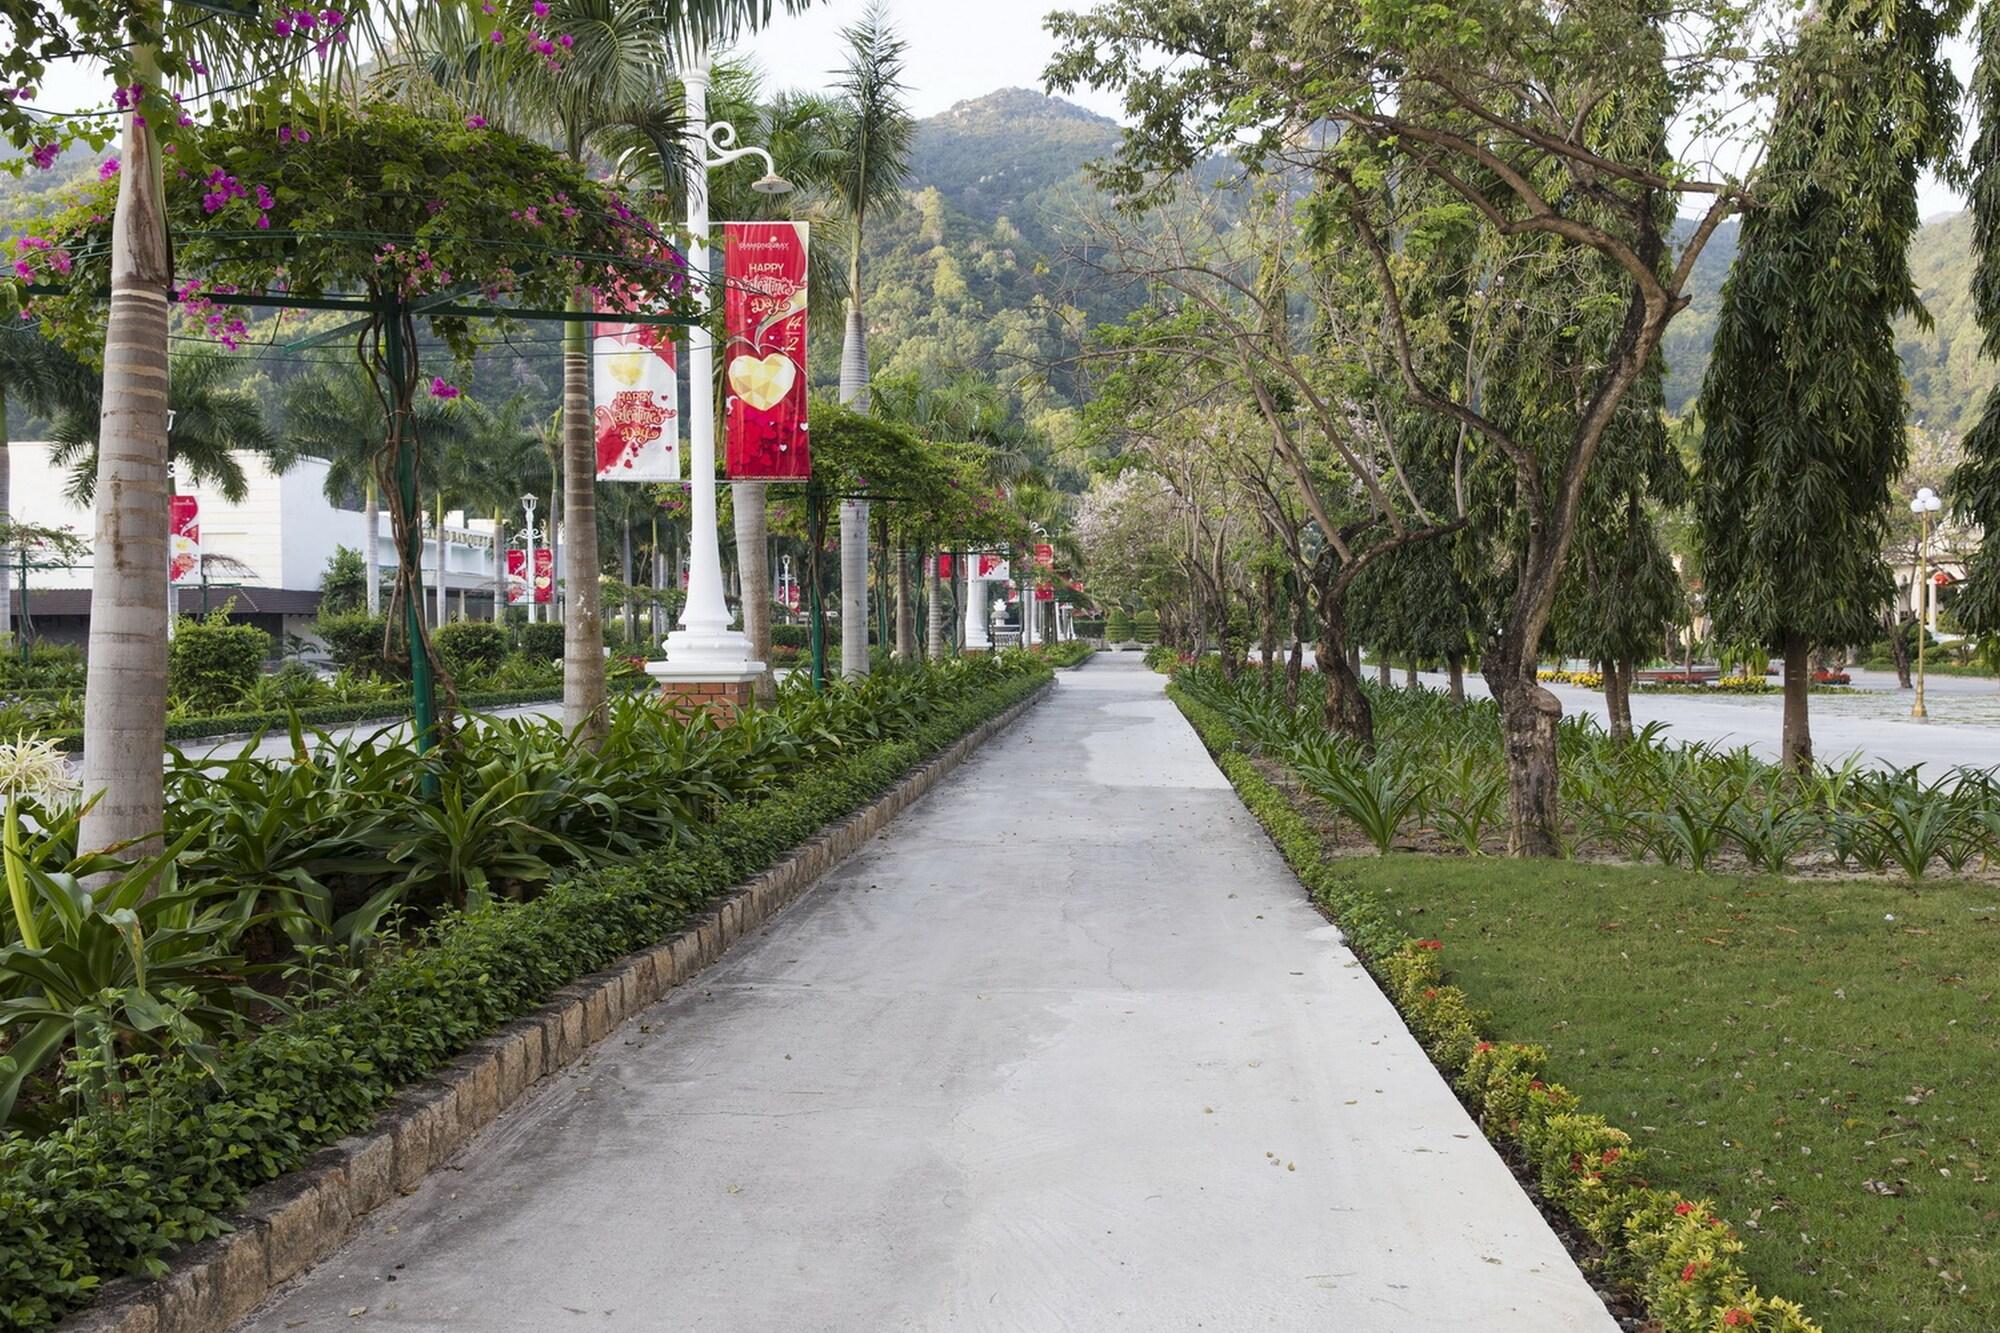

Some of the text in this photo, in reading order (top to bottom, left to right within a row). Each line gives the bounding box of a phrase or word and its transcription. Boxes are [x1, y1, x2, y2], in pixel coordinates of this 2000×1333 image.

[748, 263, 784, 276] HAPPY
[751, 297, 791, 315] Day
[617, 391, 653, 406] HAPPY
[620, 425, 661, 446] Day
